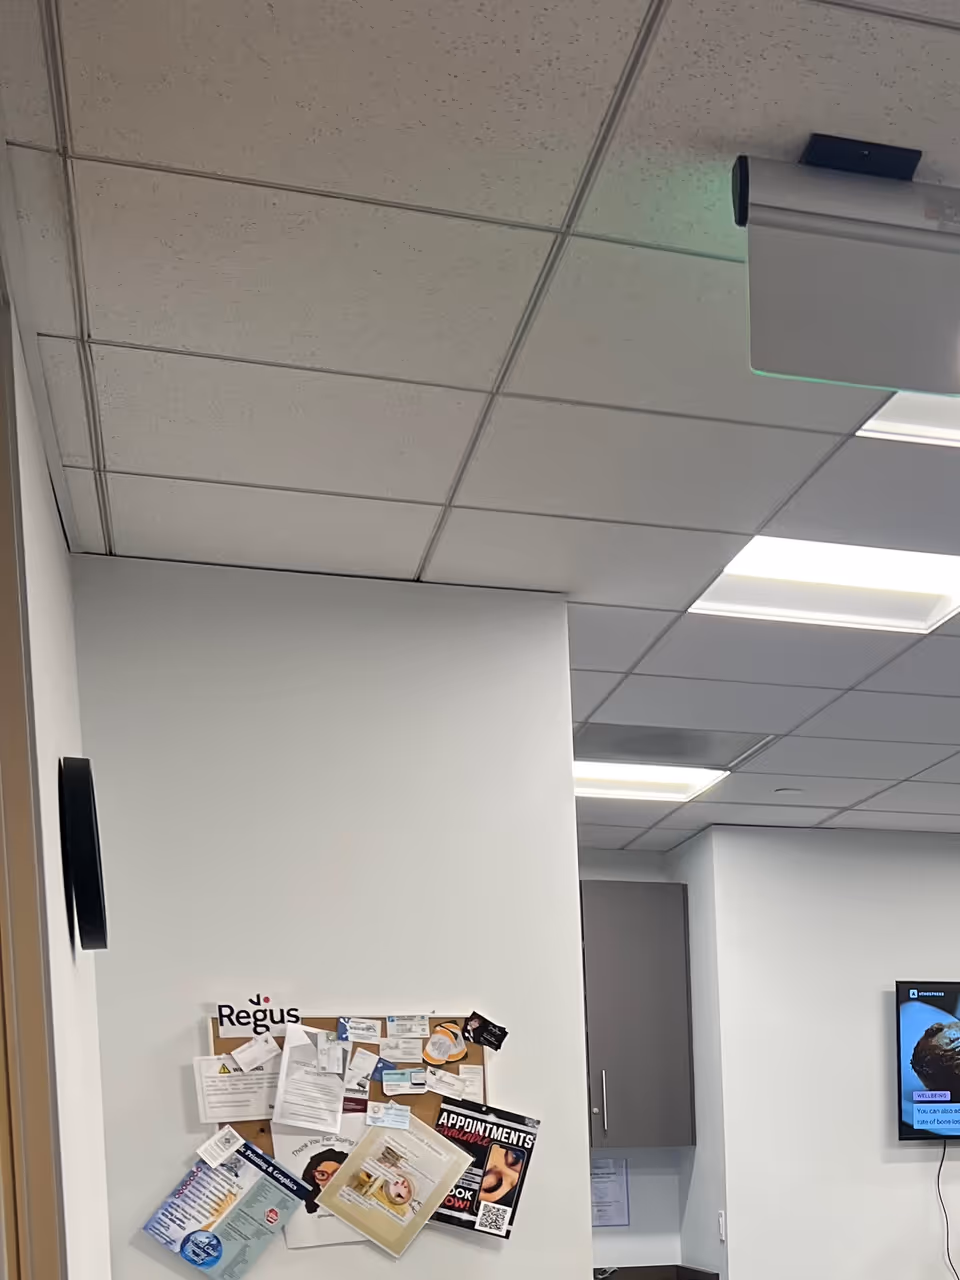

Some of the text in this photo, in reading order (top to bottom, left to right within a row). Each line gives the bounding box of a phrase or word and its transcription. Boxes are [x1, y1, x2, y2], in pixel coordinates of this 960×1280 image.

[217, 1003, 300, 1036] Regus
[292, 1142, 308, 1157] Thank
[334, 1135, 355, 1146] Saying
[438, 1111, 535, 1149] APPOINTMENTS
[245, 1149, 268, 1170] Printing
[273, 1170, 297, 1191] Graphics
